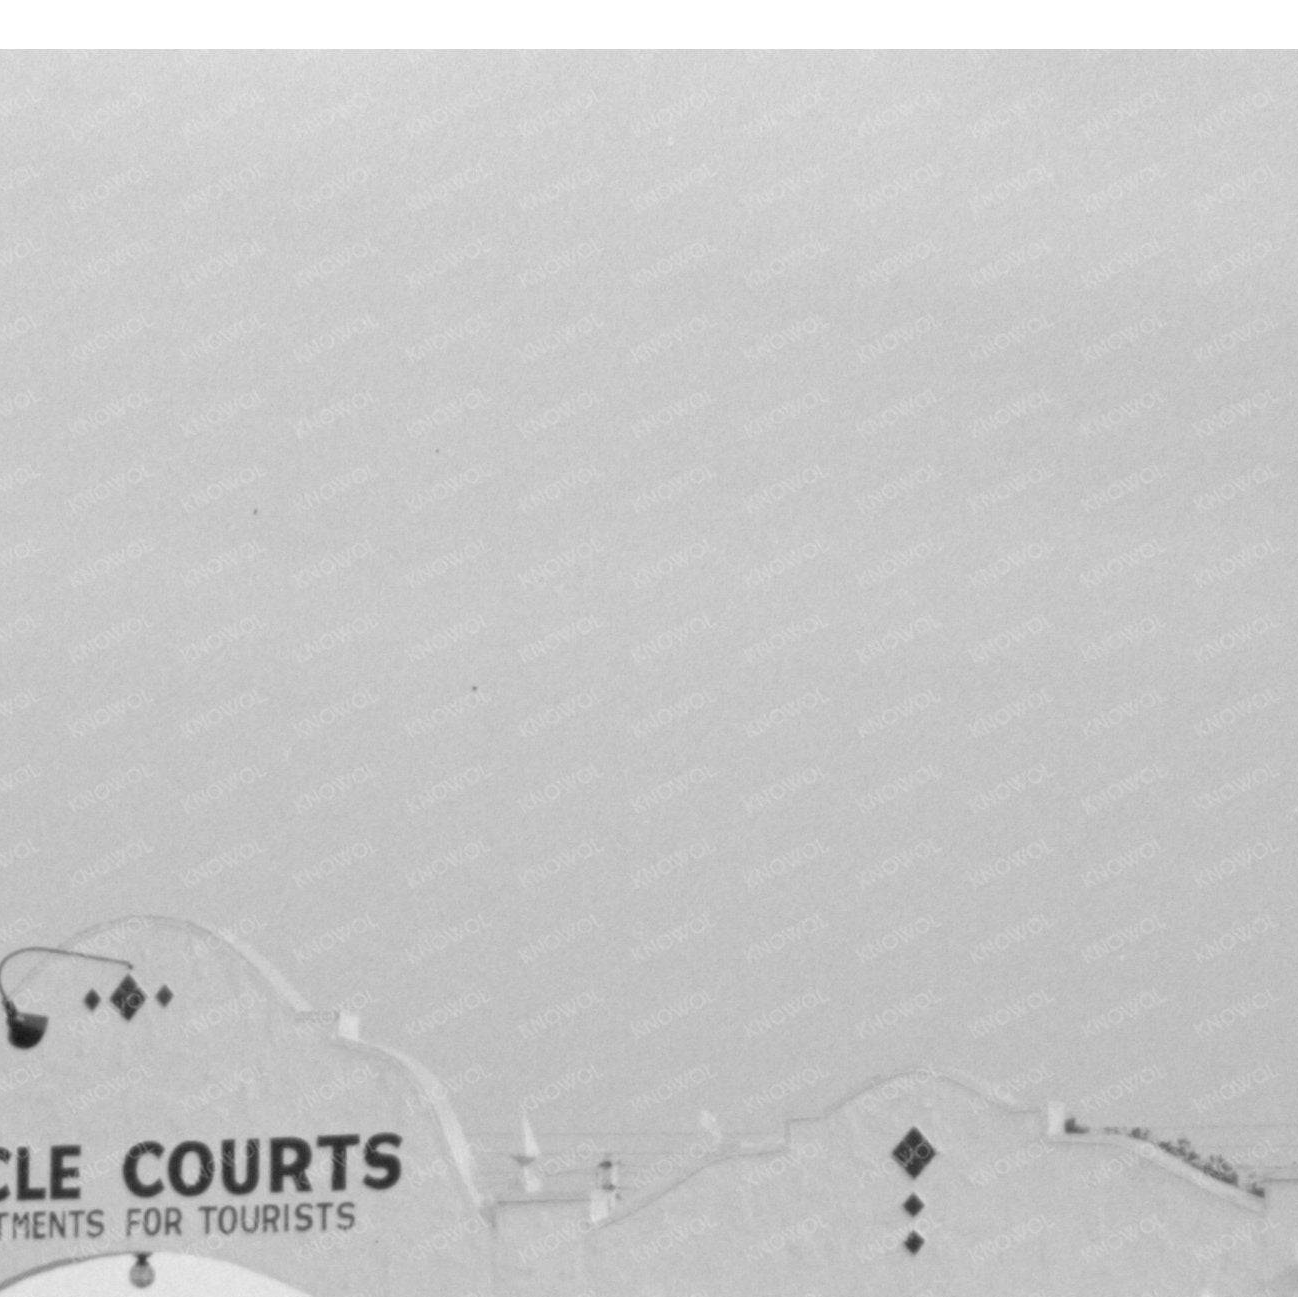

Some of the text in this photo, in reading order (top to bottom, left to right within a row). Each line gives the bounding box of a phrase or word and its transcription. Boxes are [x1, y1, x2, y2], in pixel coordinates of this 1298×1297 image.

[122, 1132, 403, 1198] COURTS
[126, 1206, 183, 1237] FOR
[198, 1201, 356, 1235] TOURISTS
